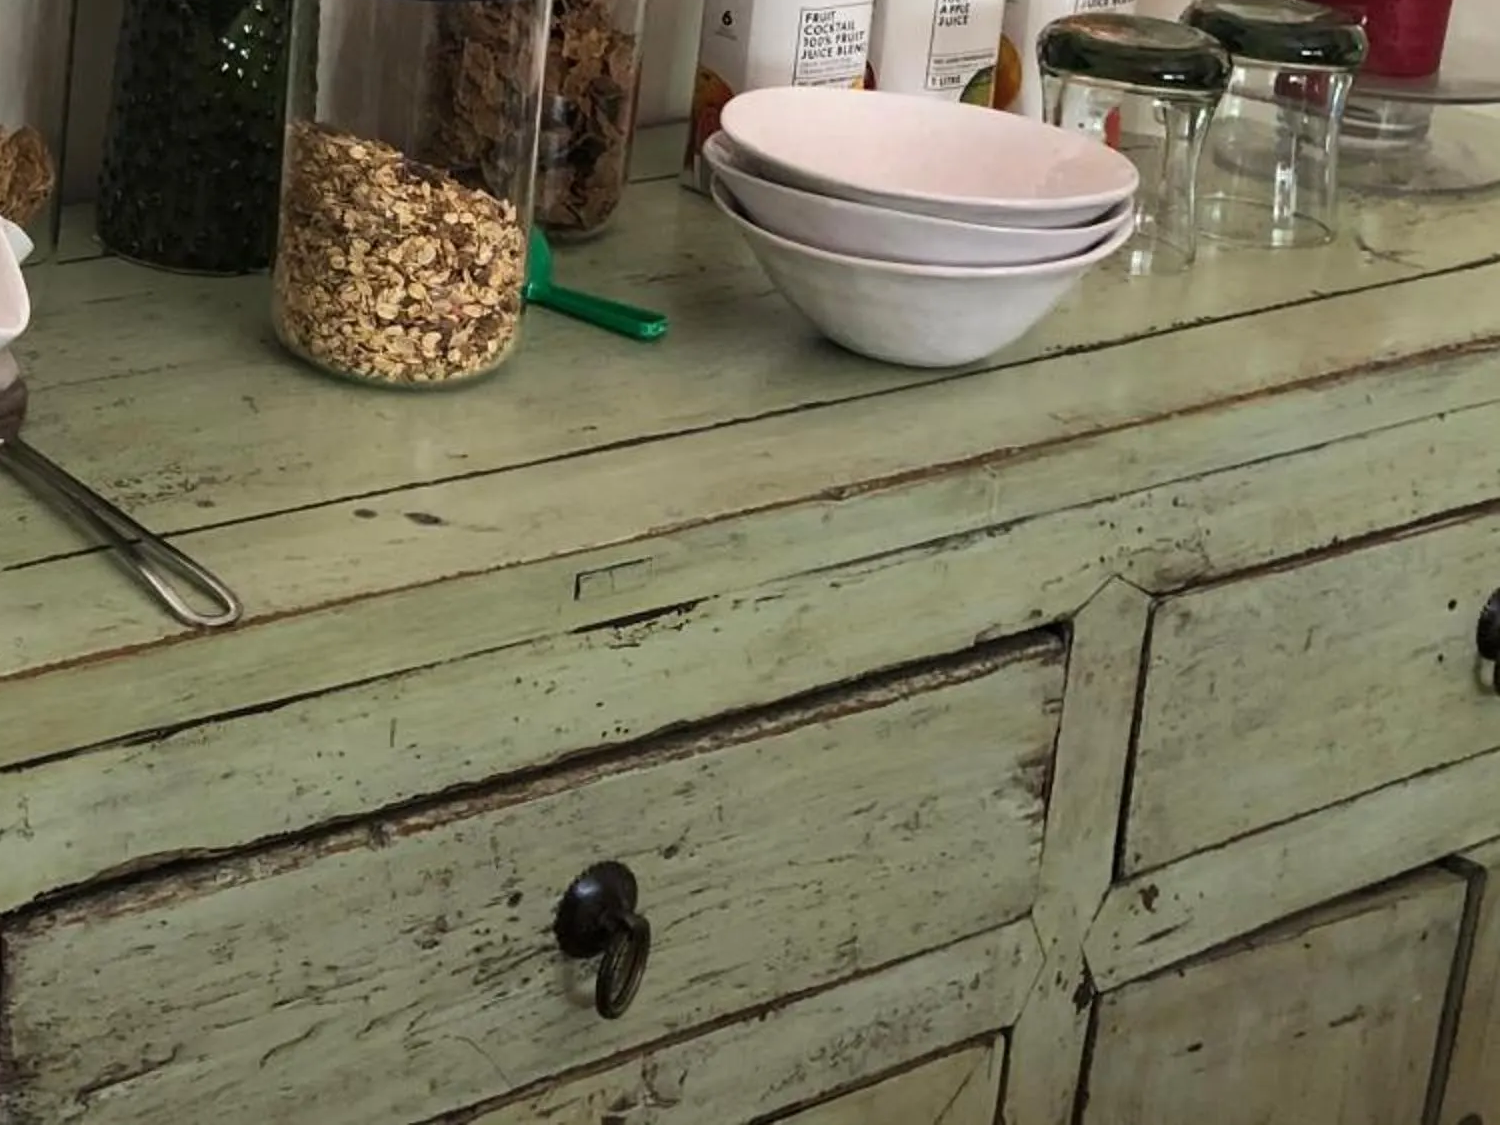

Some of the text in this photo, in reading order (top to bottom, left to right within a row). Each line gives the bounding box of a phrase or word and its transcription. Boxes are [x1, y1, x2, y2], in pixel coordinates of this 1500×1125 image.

[939, 3, 970, 14] APPLE
[722, 10, 733, 26] 6
[805, 11, 836, 23] FRUIT
[938, 15, 969, 26] JUICE
[803, 19, 855, 36] COCKTAIL
[835, 30, 864, 44] FRUIT
[801, 47, 832, 59] JUICE
